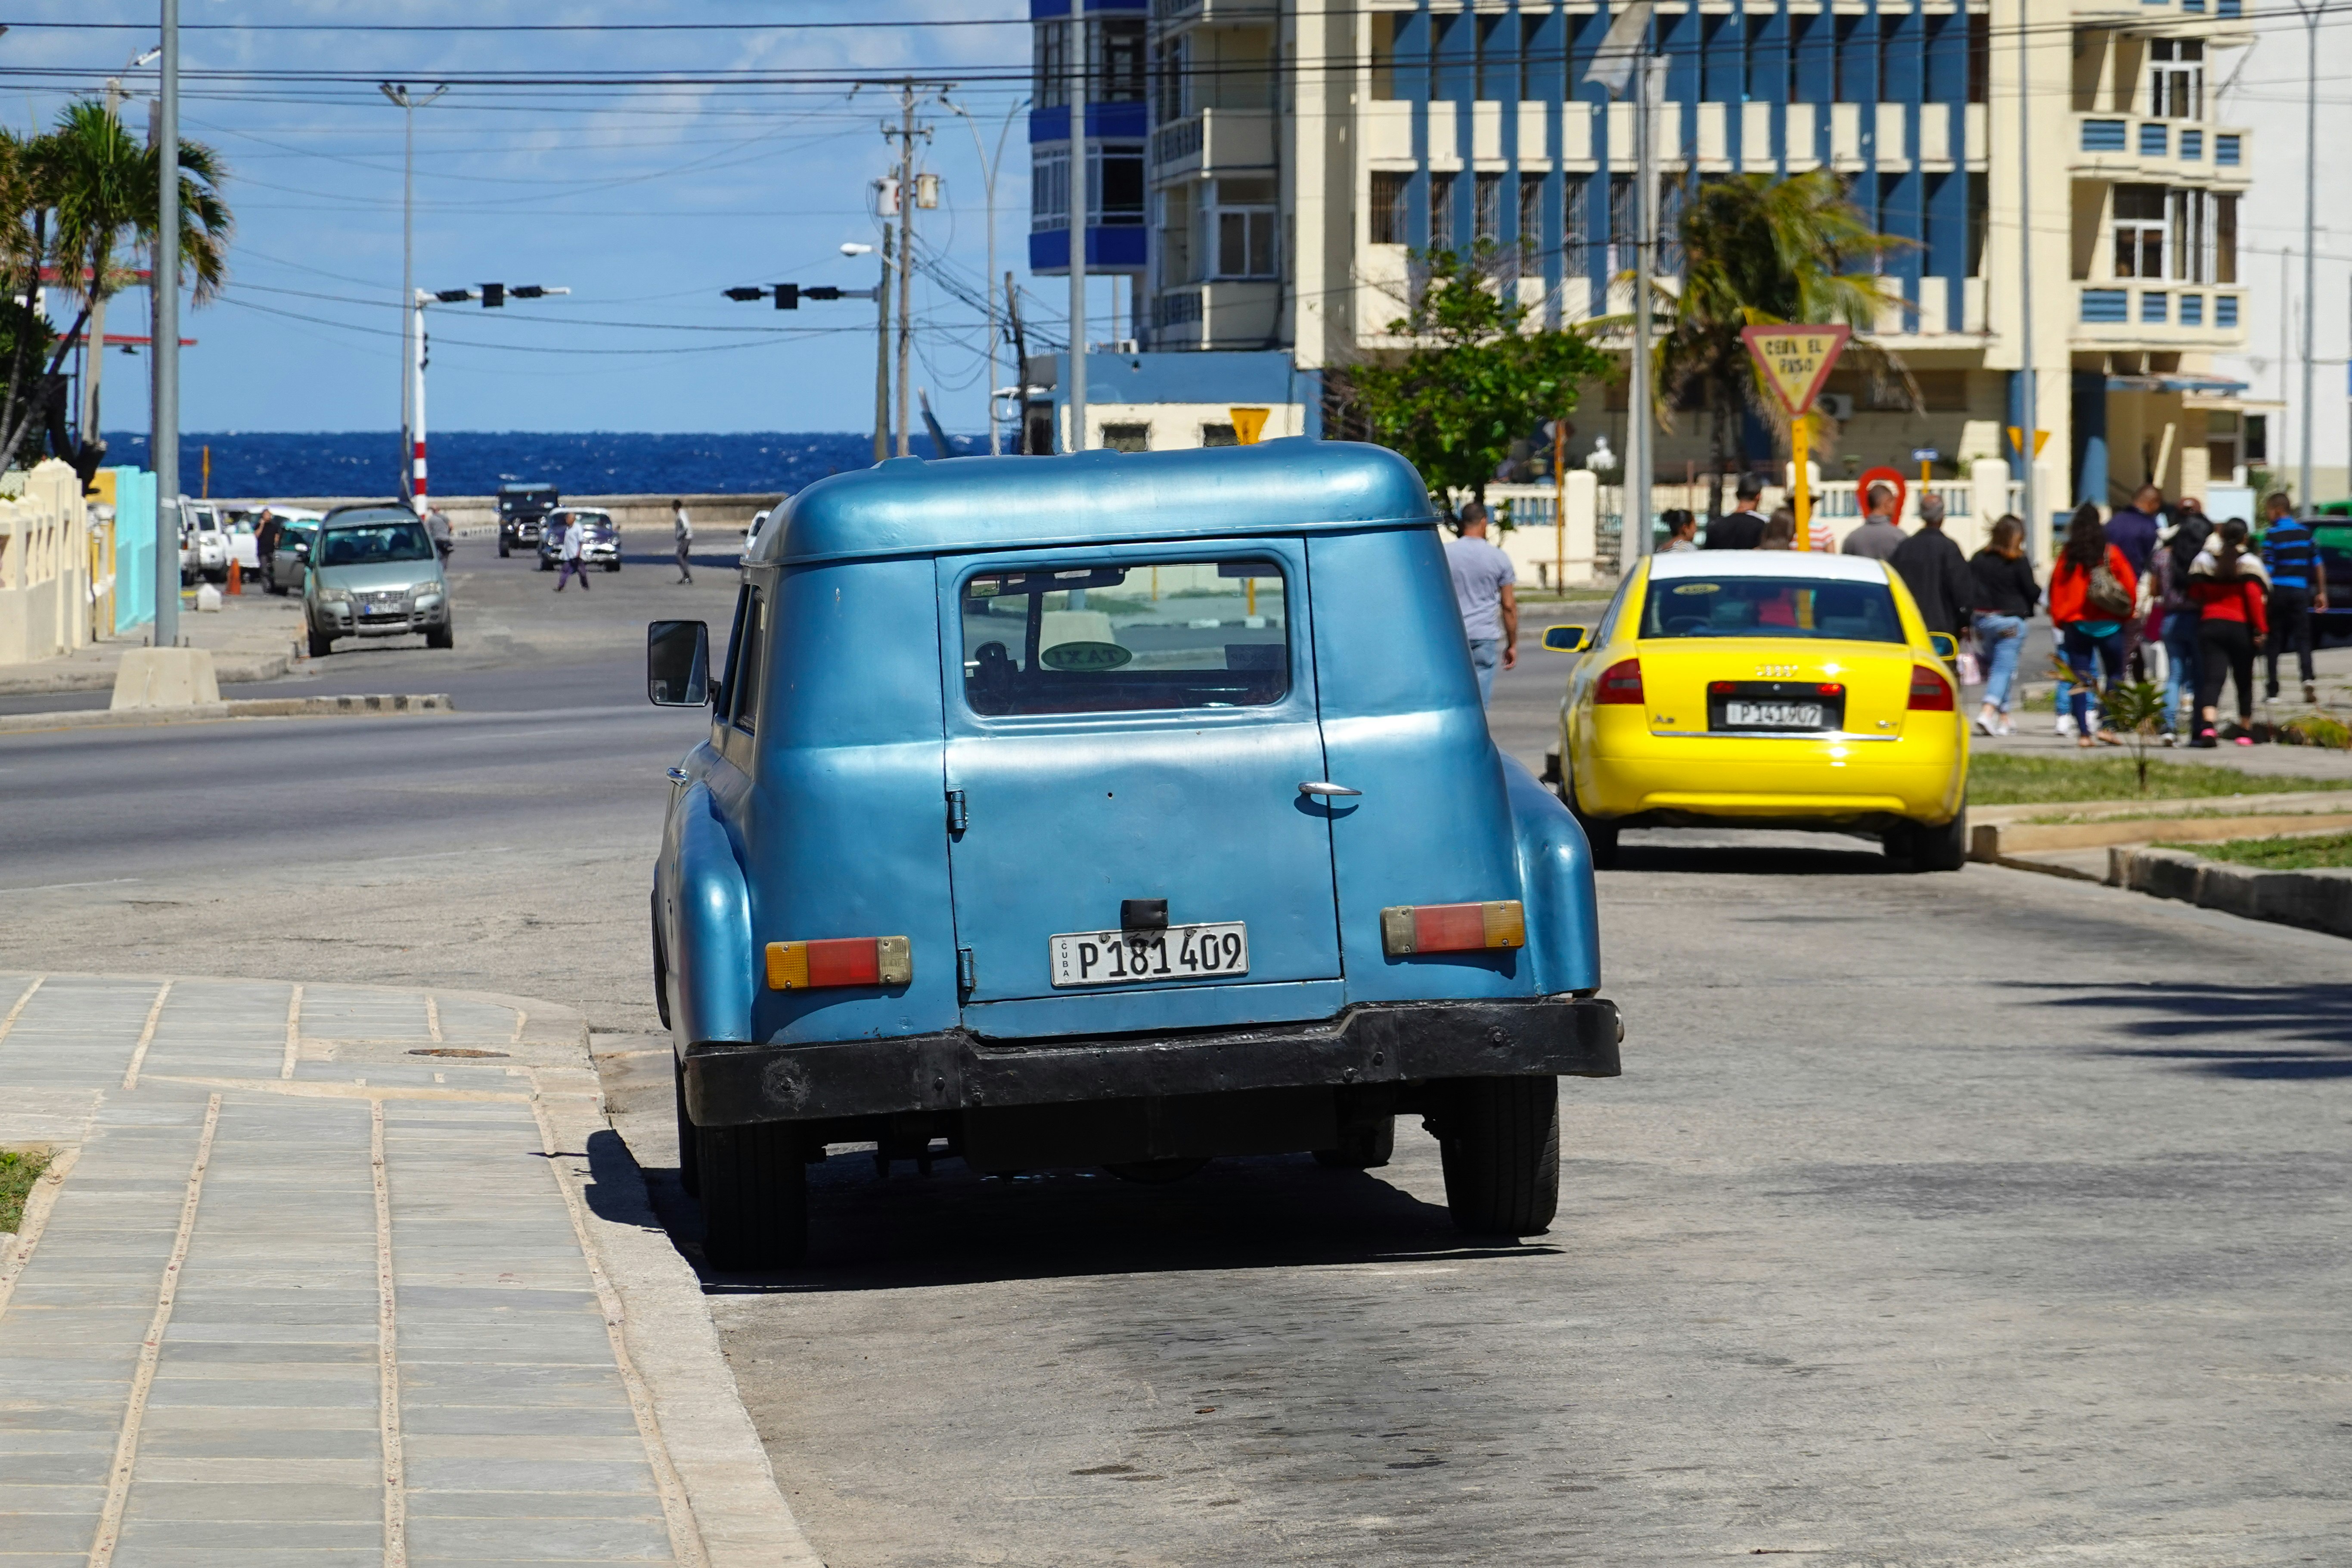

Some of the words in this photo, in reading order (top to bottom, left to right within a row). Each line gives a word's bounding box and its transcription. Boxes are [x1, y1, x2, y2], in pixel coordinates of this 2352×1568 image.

[1807, 338, 1822, 354] EL
[1779, 358, 1812, 374] PASO
[1061, 943, 1069, 977] CUBA
